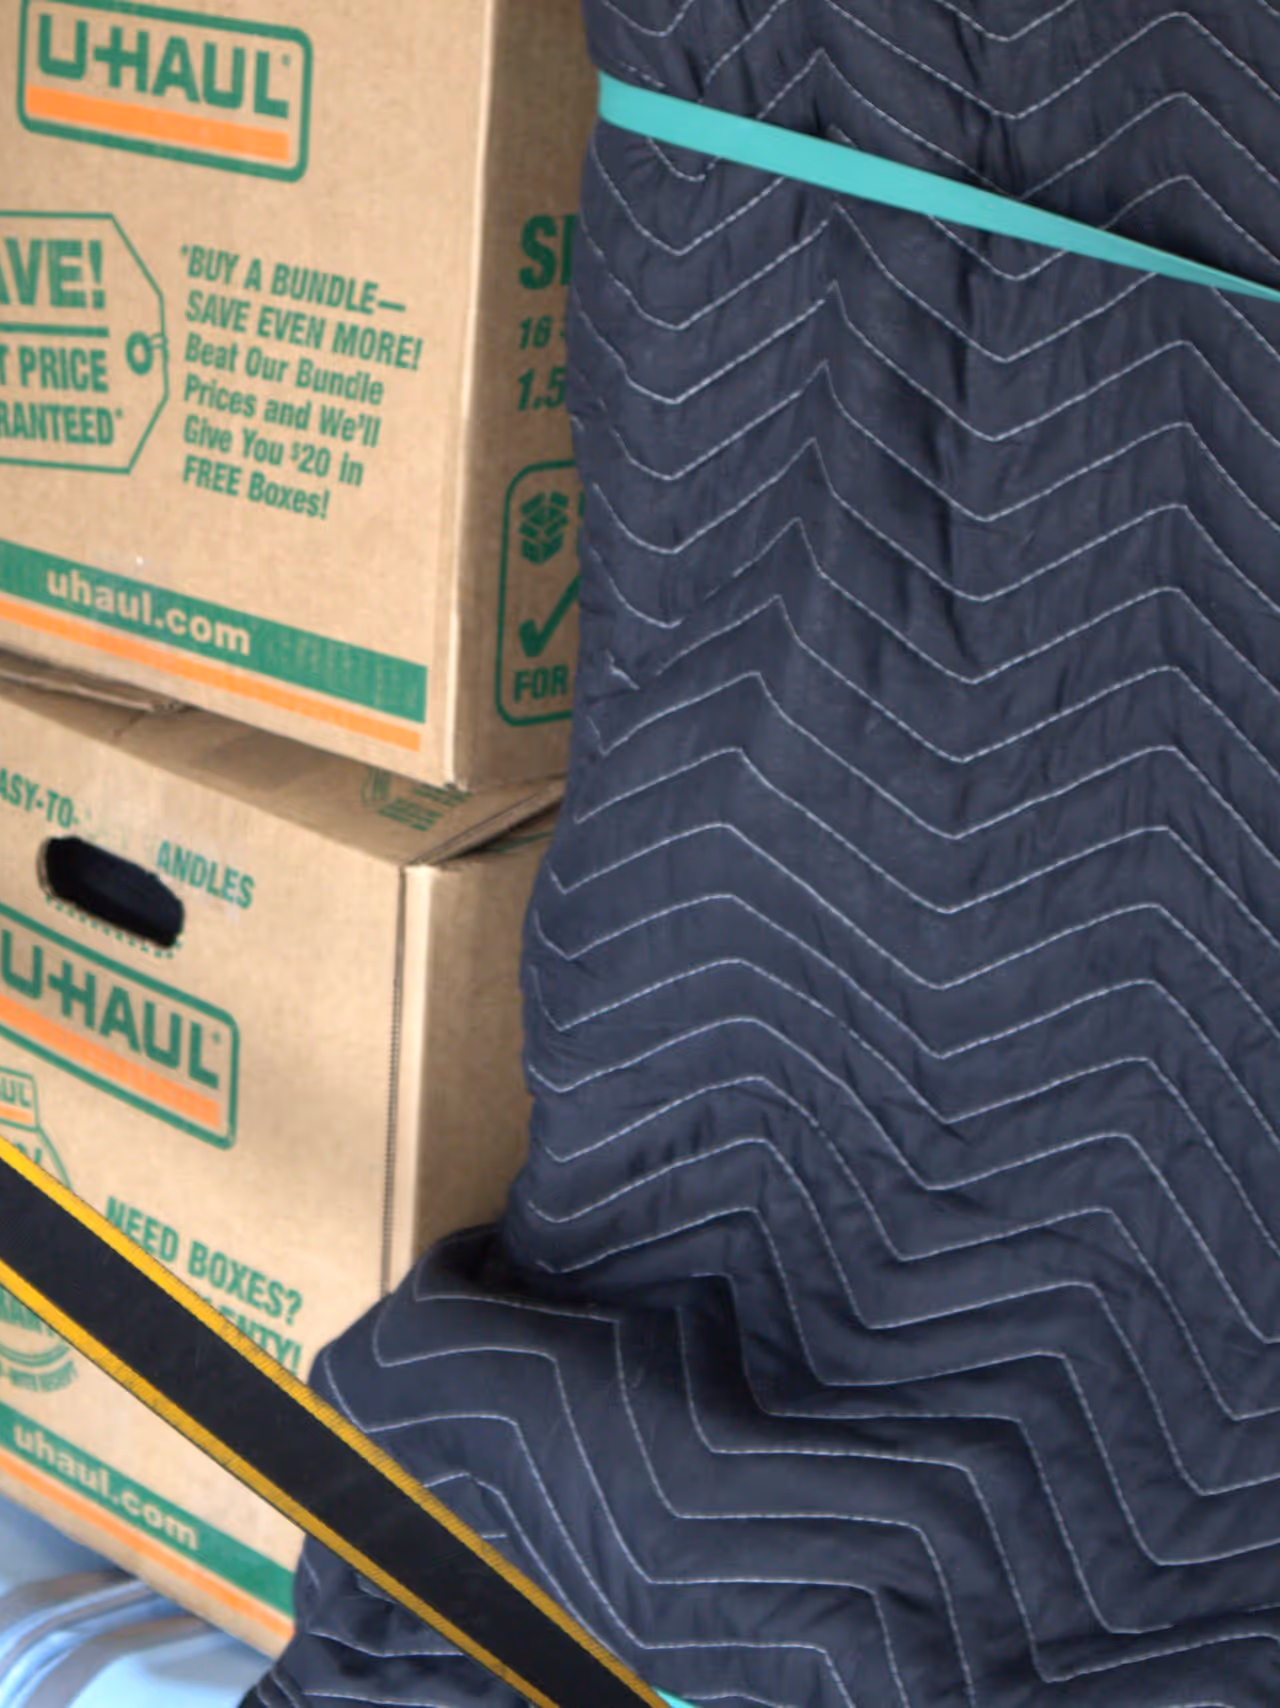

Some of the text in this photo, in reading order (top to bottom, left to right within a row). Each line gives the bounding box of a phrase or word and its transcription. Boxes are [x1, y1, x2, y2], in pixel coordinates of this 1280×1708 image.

[243, 257, 262, 293] A
[184, 288, 424, 372] SAVE EVEN MORE!
[18, 344, 110, 393] PRICE
[184, 331, 385, 406] Beat Our Bundle
[184, 372, 382, 449] Prices and We'll
[183, 413, 365, 488] Give You $20 in
[183, 453, 331, 521] FREE Boxes!
[47, 569, 250, 657] uhaul.com
[513, 664, 569, 704] FOR
[156, 838, 256, 911] ANDLES
[106, 1195, 303, 1326] NEED BOXES?
[13, 1425, 199, 1551] uhaul.com
